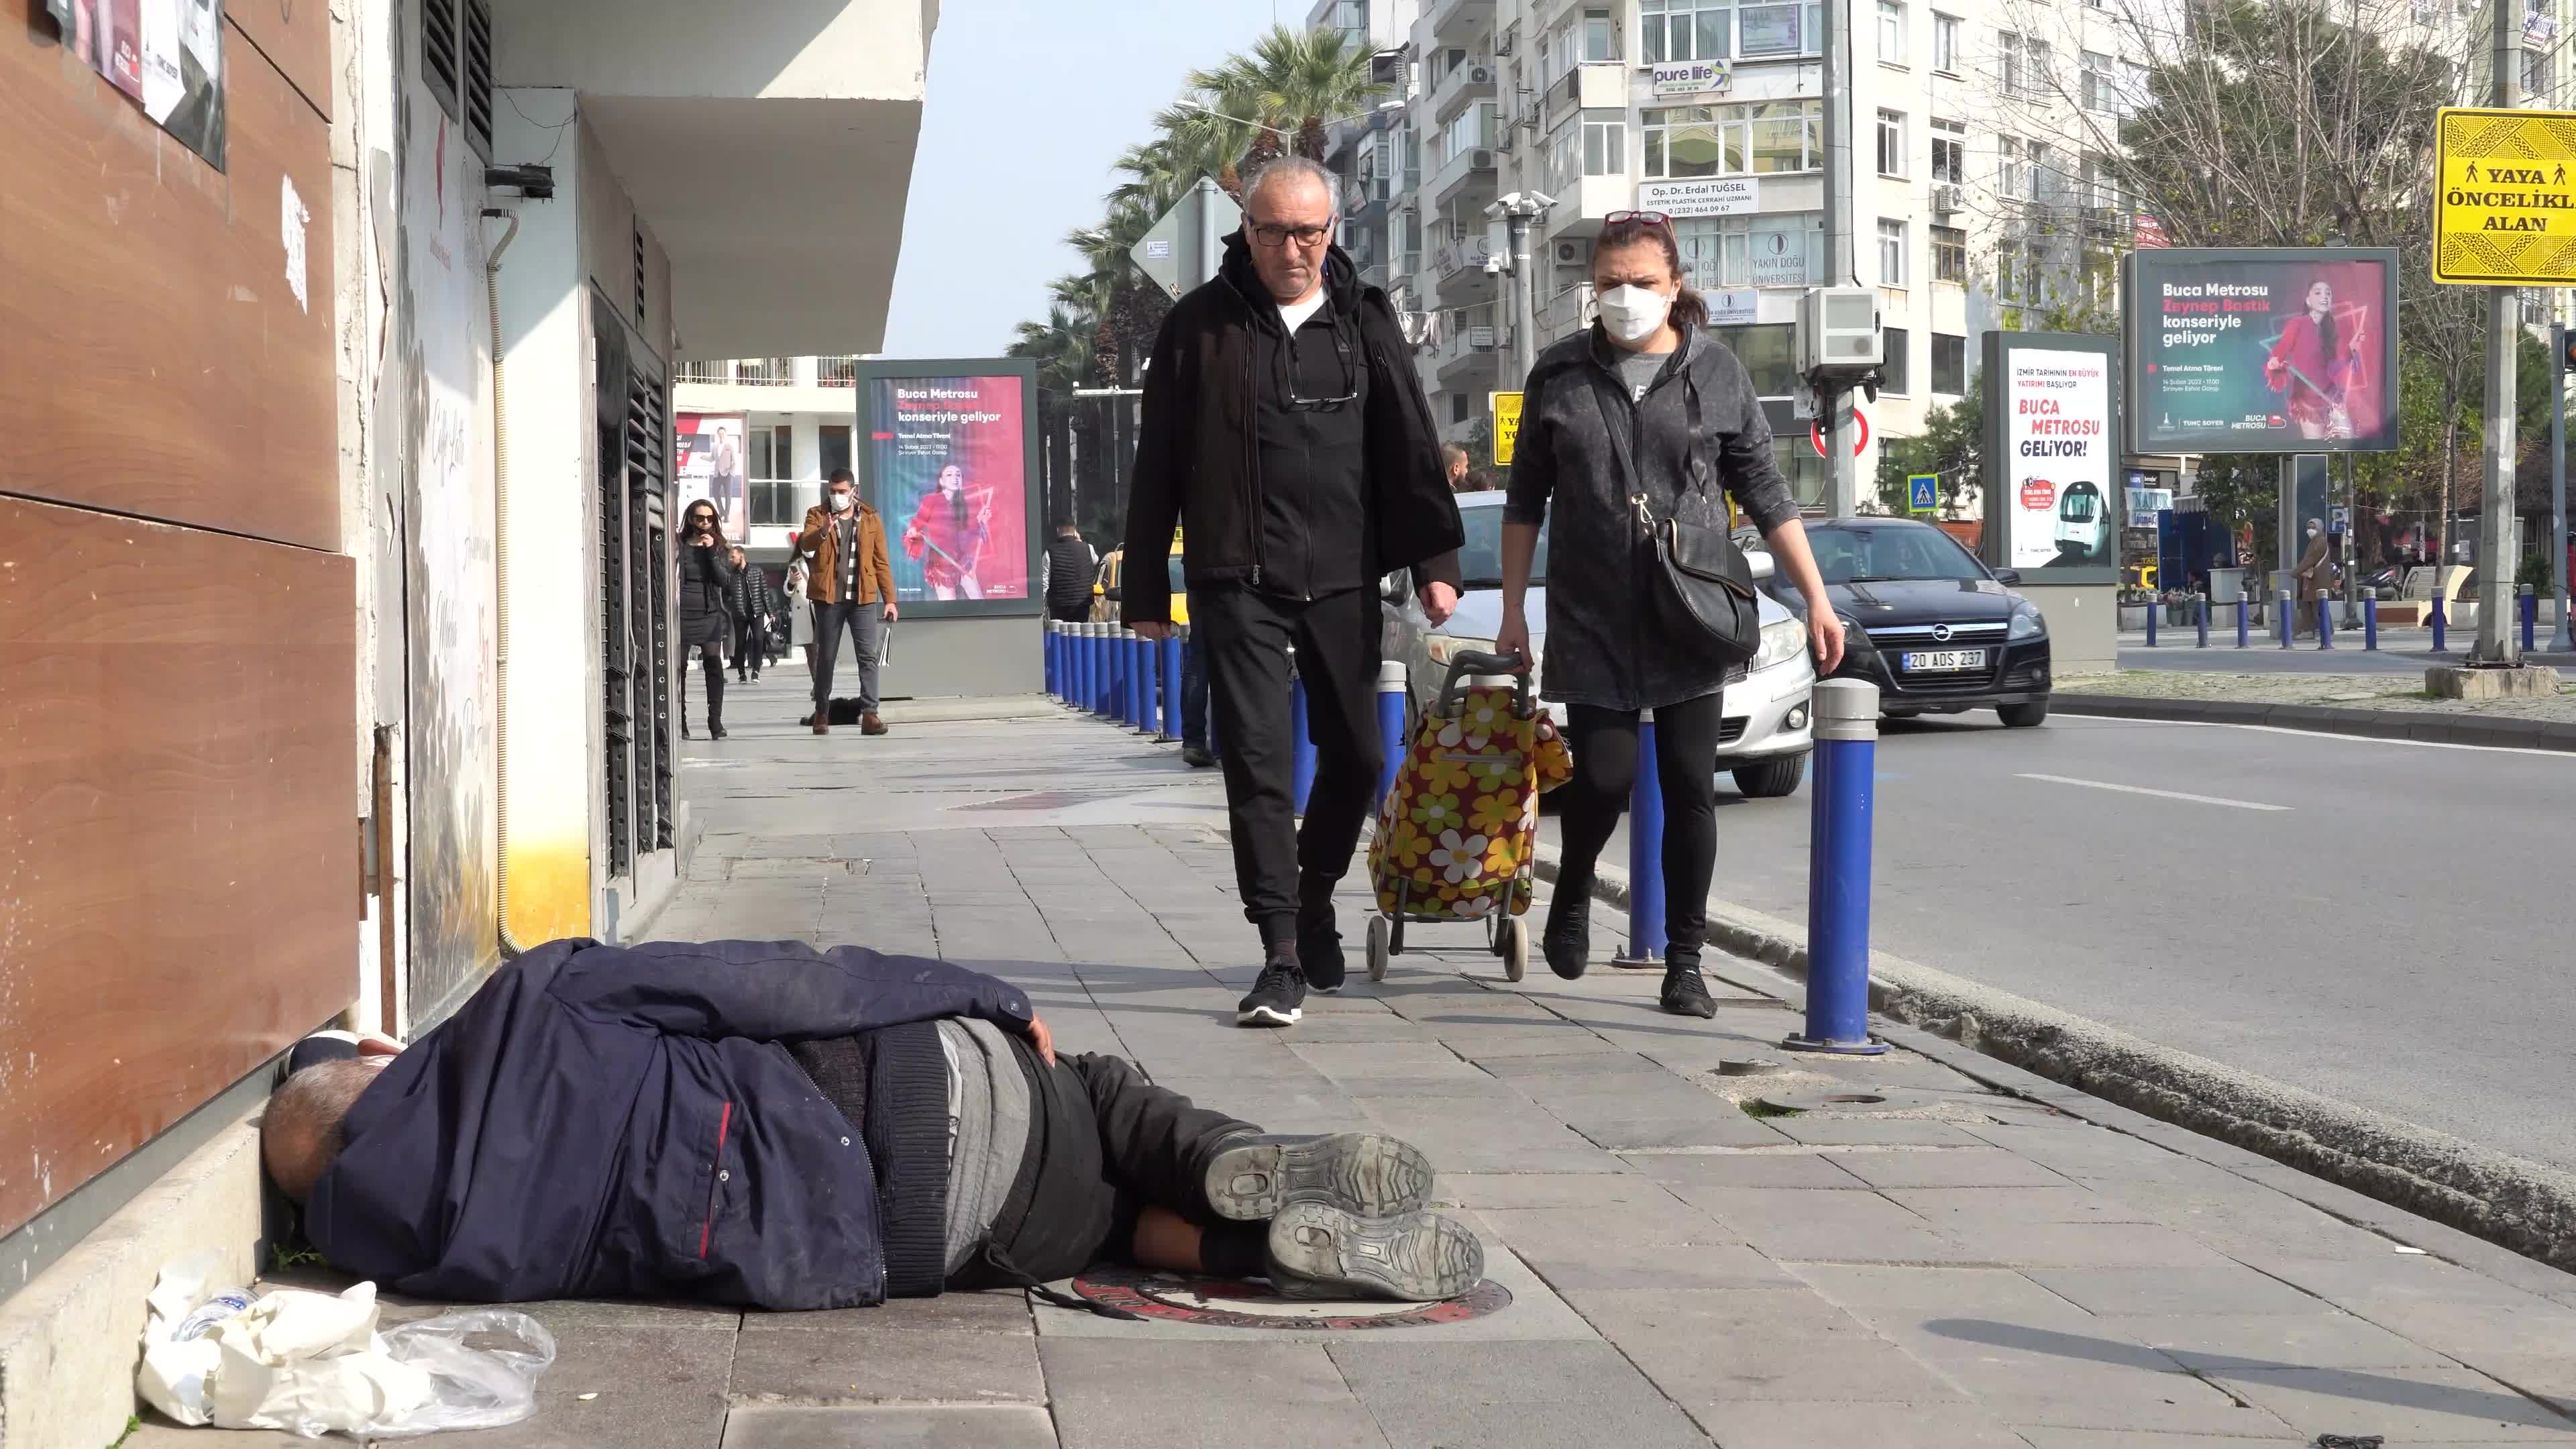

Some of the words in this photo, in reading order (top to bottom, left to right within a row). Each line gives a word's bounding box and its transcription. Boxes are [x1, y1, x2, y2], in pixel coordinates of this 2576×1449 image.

[1654, 68, 1688, 85] pure
[1692, 66, 1713, 80] life
[2487, 168, 2547, 184] YAYA
[1652, 188, 1668, 197] Op.
[1670, 187, 1684, 195] Dr.
[1685, 185, 1709, 195] Erdal
[1711, 182, 1746, 193] TUĞSEL
[2447, 186, 2576, 209] ÖNCELİKL
[1674, 207, 1694, 215] (232)
[2482, 216, 2548, 232] ALAN
[1752, 258, 1778, 269] YAKIN
[1780, 255, 1805, 268] DOĞU
[2162, 283, 2202, 297] Buca
[2206, 283, 2268, 297] Metrosu
[2162, 299, 2219, 315] Zeynep
[2162, 314, 2241, 331] konseriyle
[2162, 330, 2216, 347] geliyor
[2078, 368, 2099, 377] BÜYÜK
[897, 388, 927, 398] Buca
[930, 388, 978, 398] Metrosu
[2019, 398, 2060, 415] BUCA
[898, 411, 959, 424] konseriyle
[960, 411, 1002, 425] geliyor
[2231, 422, 2266, 430] METROSU
[2245, 414, 2267, 422] BUCA
[2031, 419, 2100, 435] METROSU
[1911, 654, 1926, 667] 20
[1932, 653, 1954, 667] ADS
[1960, 651, 1982, 665] 237
